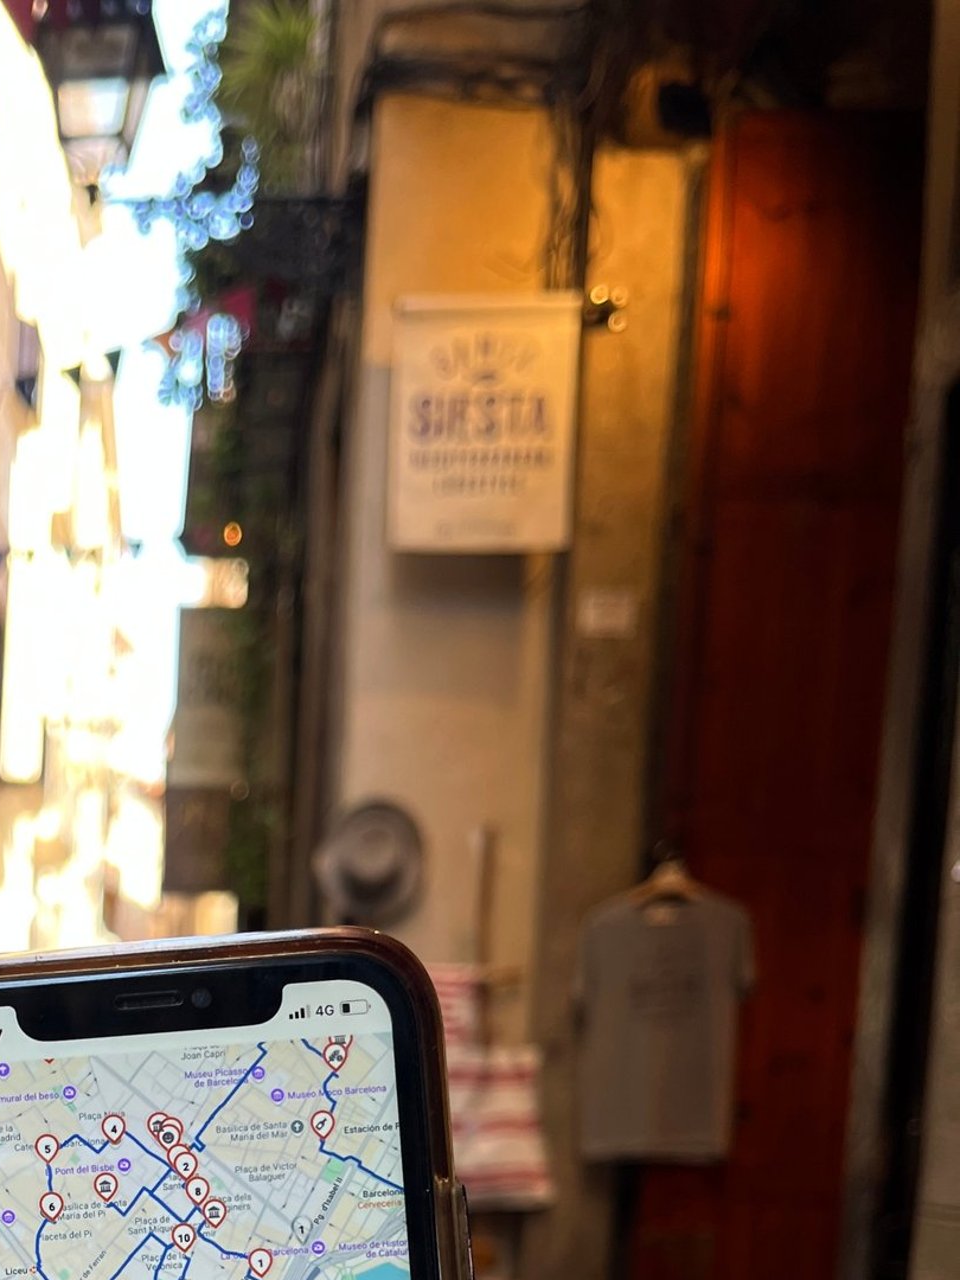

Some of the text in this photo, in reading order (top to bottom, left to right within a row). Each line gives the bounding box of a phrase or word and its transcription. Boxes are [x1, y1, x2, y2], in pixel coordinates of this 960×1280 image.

[315, 1004, 335, 1016] 4G
[184, 1070, 213, 1079] Museu
[194, 1080, 205, 1088] de
[24, 1093, 37, 1101] del
[39, 1091, 60, 1100] beso
[287, 1090, 316, 1099] Museo
[344, 1085, 387, 1096] Barcelona
[5, 1124, 14, 1132] la
[111, 1125, 118, 1134] 4
[250, 1122, 261, 1131] de
[263, 1121, 288, 1130] Santa
[344, 1124, 381, 1134] Estación
[382, 1121, 393, 1131] de
[44, 1145, 52, 1154] 5
[55, 1167, 75, 1175] Pont
[76, 1166, 89, 1174] del
[90, 1164, 115, 1173] Bisbe
[182, 1162, 190, 1171] 2
[260, 1164, 271, 1172] de
[194, 1188, 201, 1197] 8
[49, 1202, 56, 1211] 6
[91, 1201, 102, 1209] de
[82, 1210, 95, 1219] del
[134, 1215, 171, 1226] Plaça de
[69, 1231, 81, 1240] del
[83, 1230, 92, 1238] Pi
[128, 1226, 148, 1236] Sant
[178, 1233, 191, 1243] 10
[338, 1242, 368, 1252] Museo
[369, 1241, 380, 1249] de
[166, 1252, 178, 1260] de
[365, 1250, 377, 1259] de
[5, 1267, 28, 1276] Liceu
